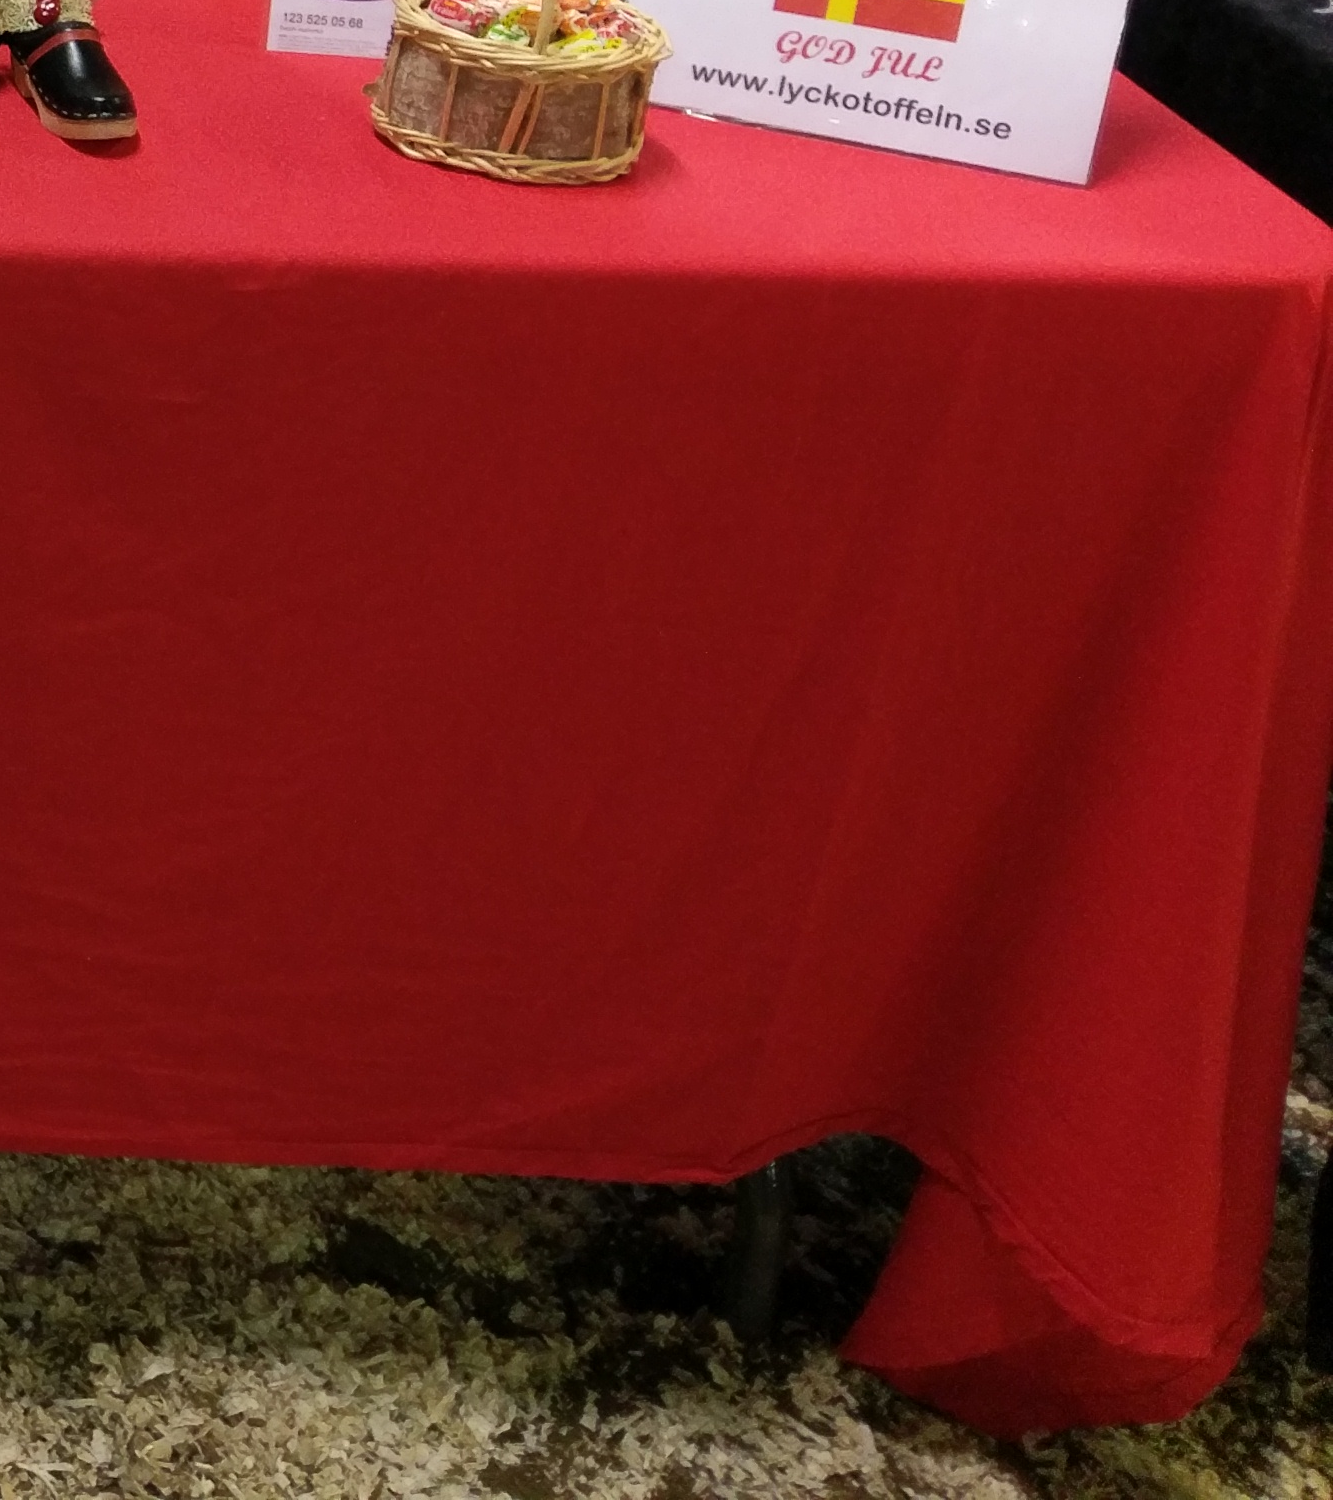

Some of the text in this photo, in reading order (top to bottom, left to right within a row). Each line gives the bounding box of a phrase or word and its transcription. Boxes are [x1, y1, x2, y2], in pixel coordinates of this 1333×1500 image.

[283, 12, 303, 23] 123
[306, 14, 328, 26] 525
[331, 16, 346, 27] 05
[775, 30, 944, 82] GOD JUL
[691, 64, 1013, 141] www.lyckotoffeln.se
